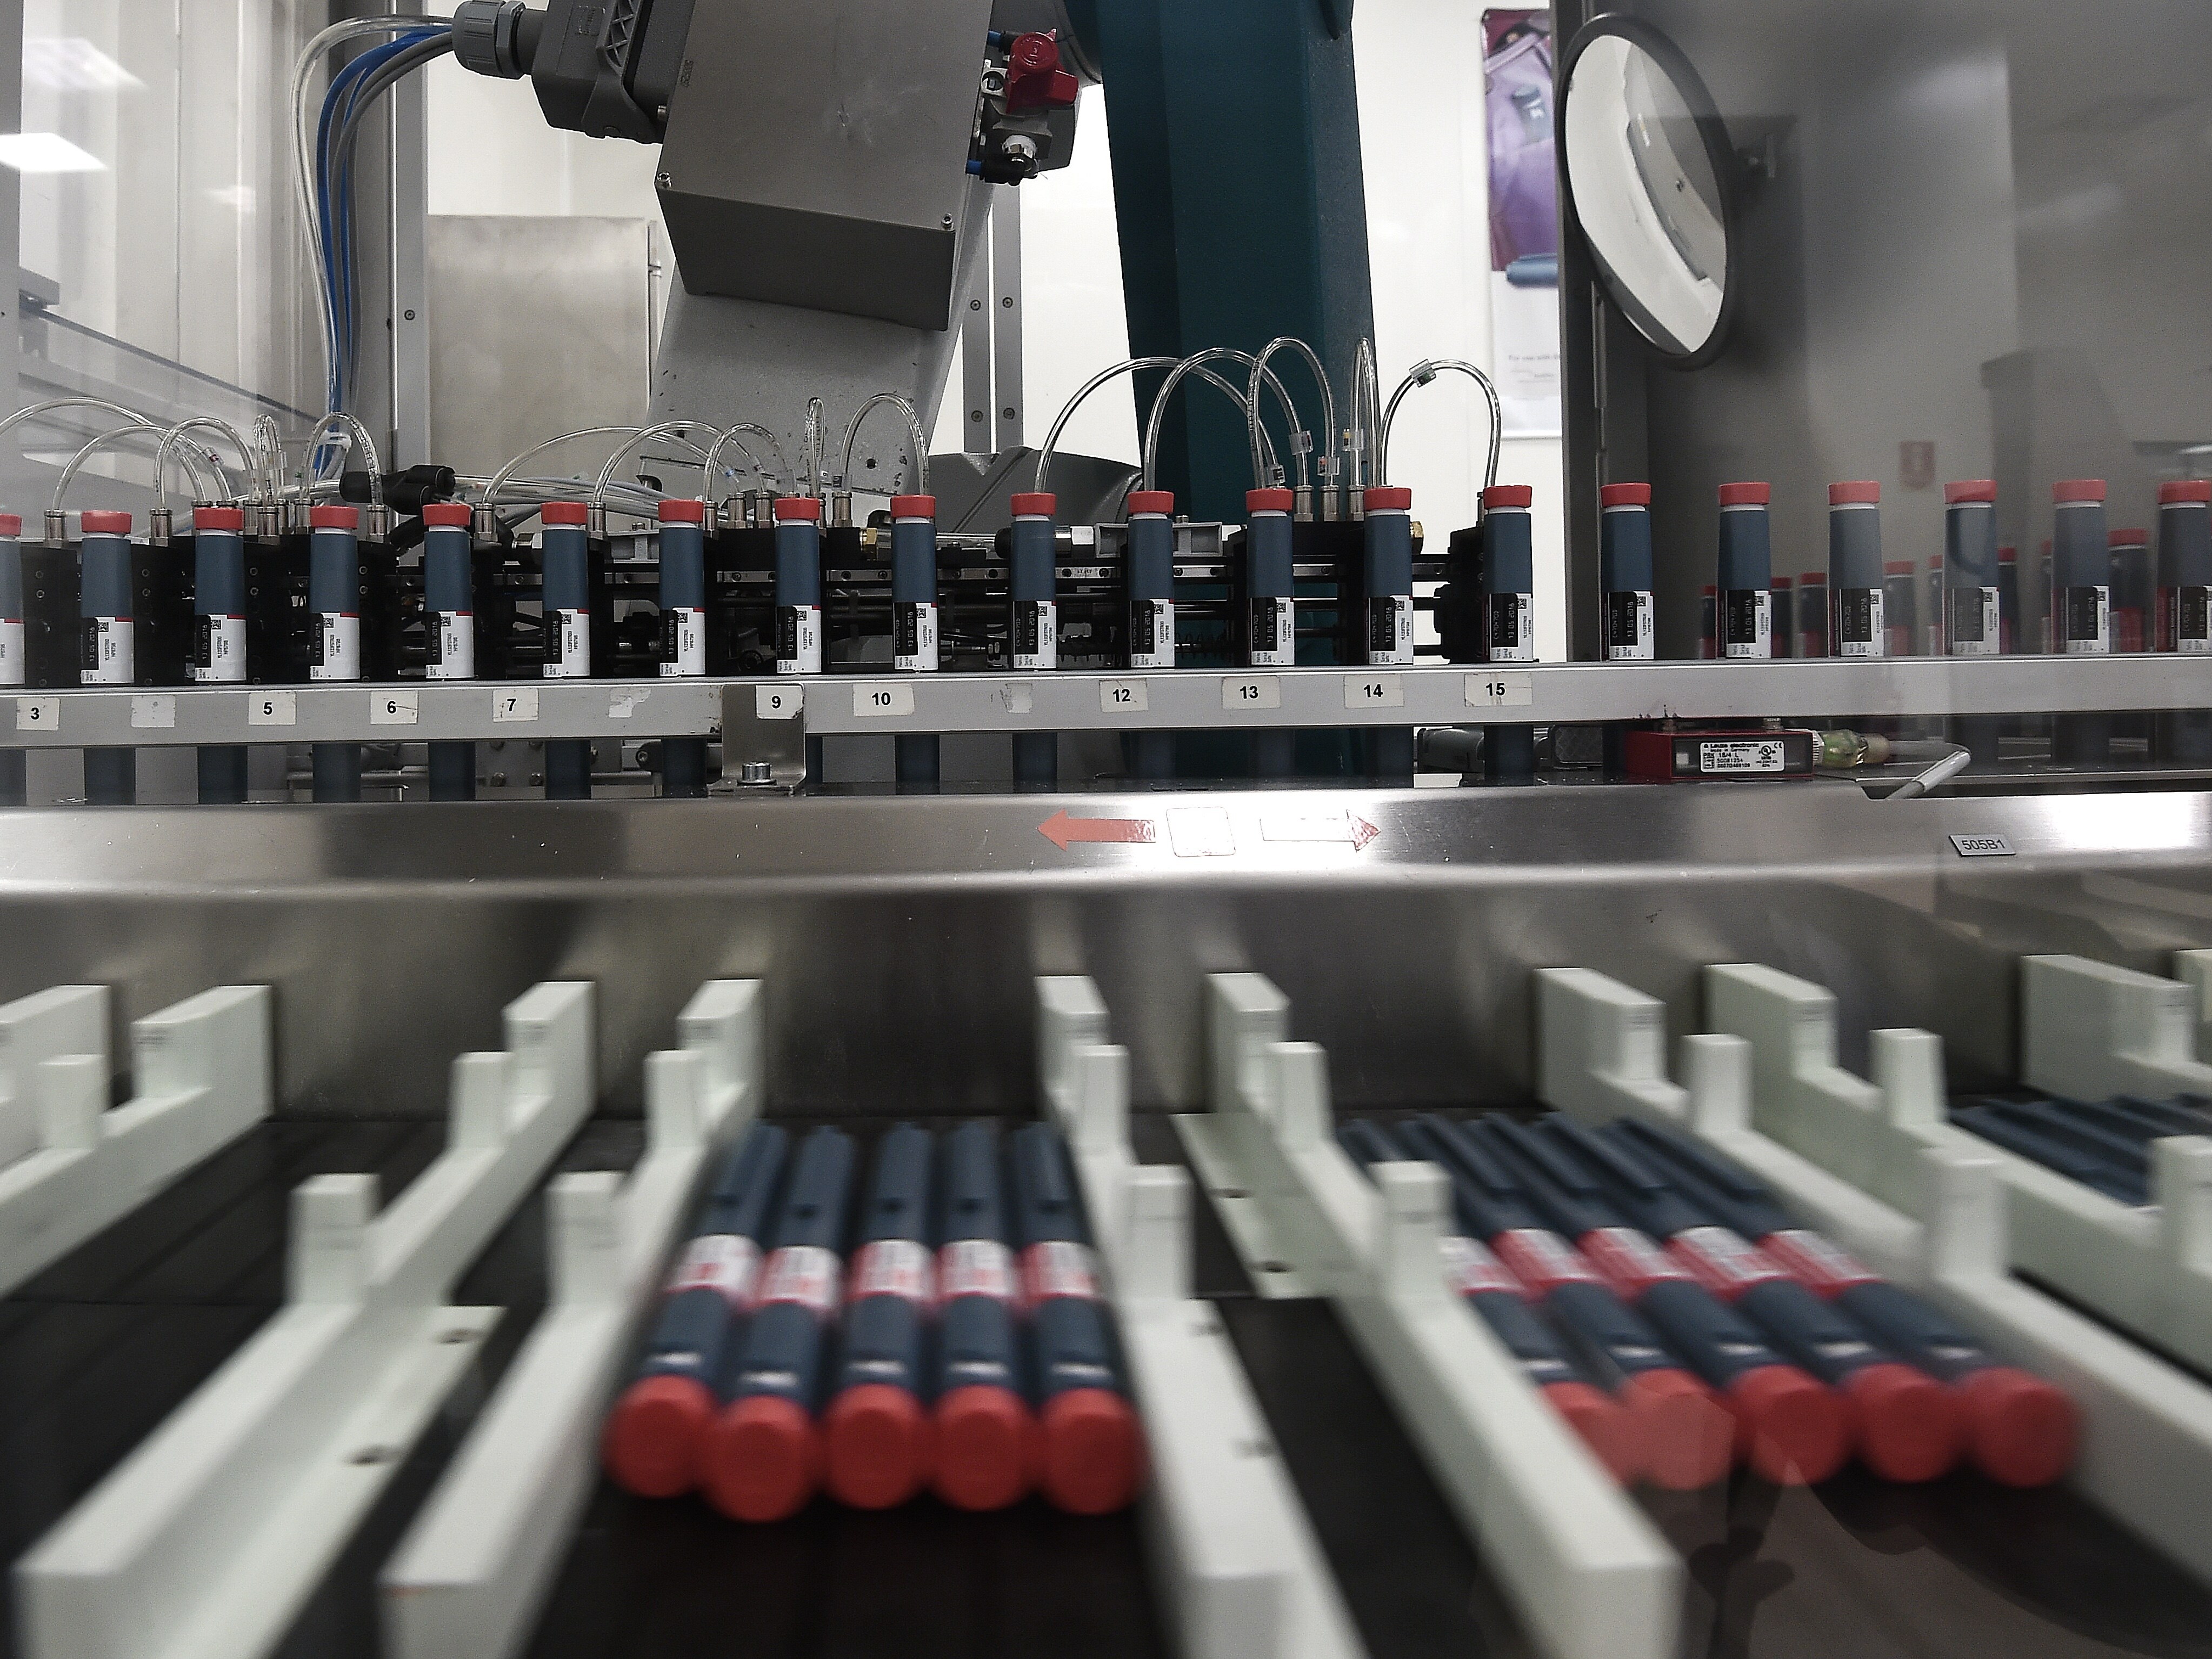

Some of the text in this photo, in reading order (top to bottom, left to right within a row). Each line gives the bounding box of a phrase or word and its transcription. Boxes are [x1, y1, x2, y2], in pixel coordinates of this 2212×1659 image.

[1112, 689, 1131, 702] 12
[1240, 685, 1258, 699] 13
[1363, 684, 1383, 698] 14
[1485, 682, 1505, 696] 15
[507, 698, 516, 711] 7
[771, 695, 781, 709] 9
[871, 692, 891, 706] 10
[30, 707, 39, 720] 3
[263, 702, 272, 715] 5
[387, 701, 397, 714] 6
[1962, 839, 2005, 850] 505B1
